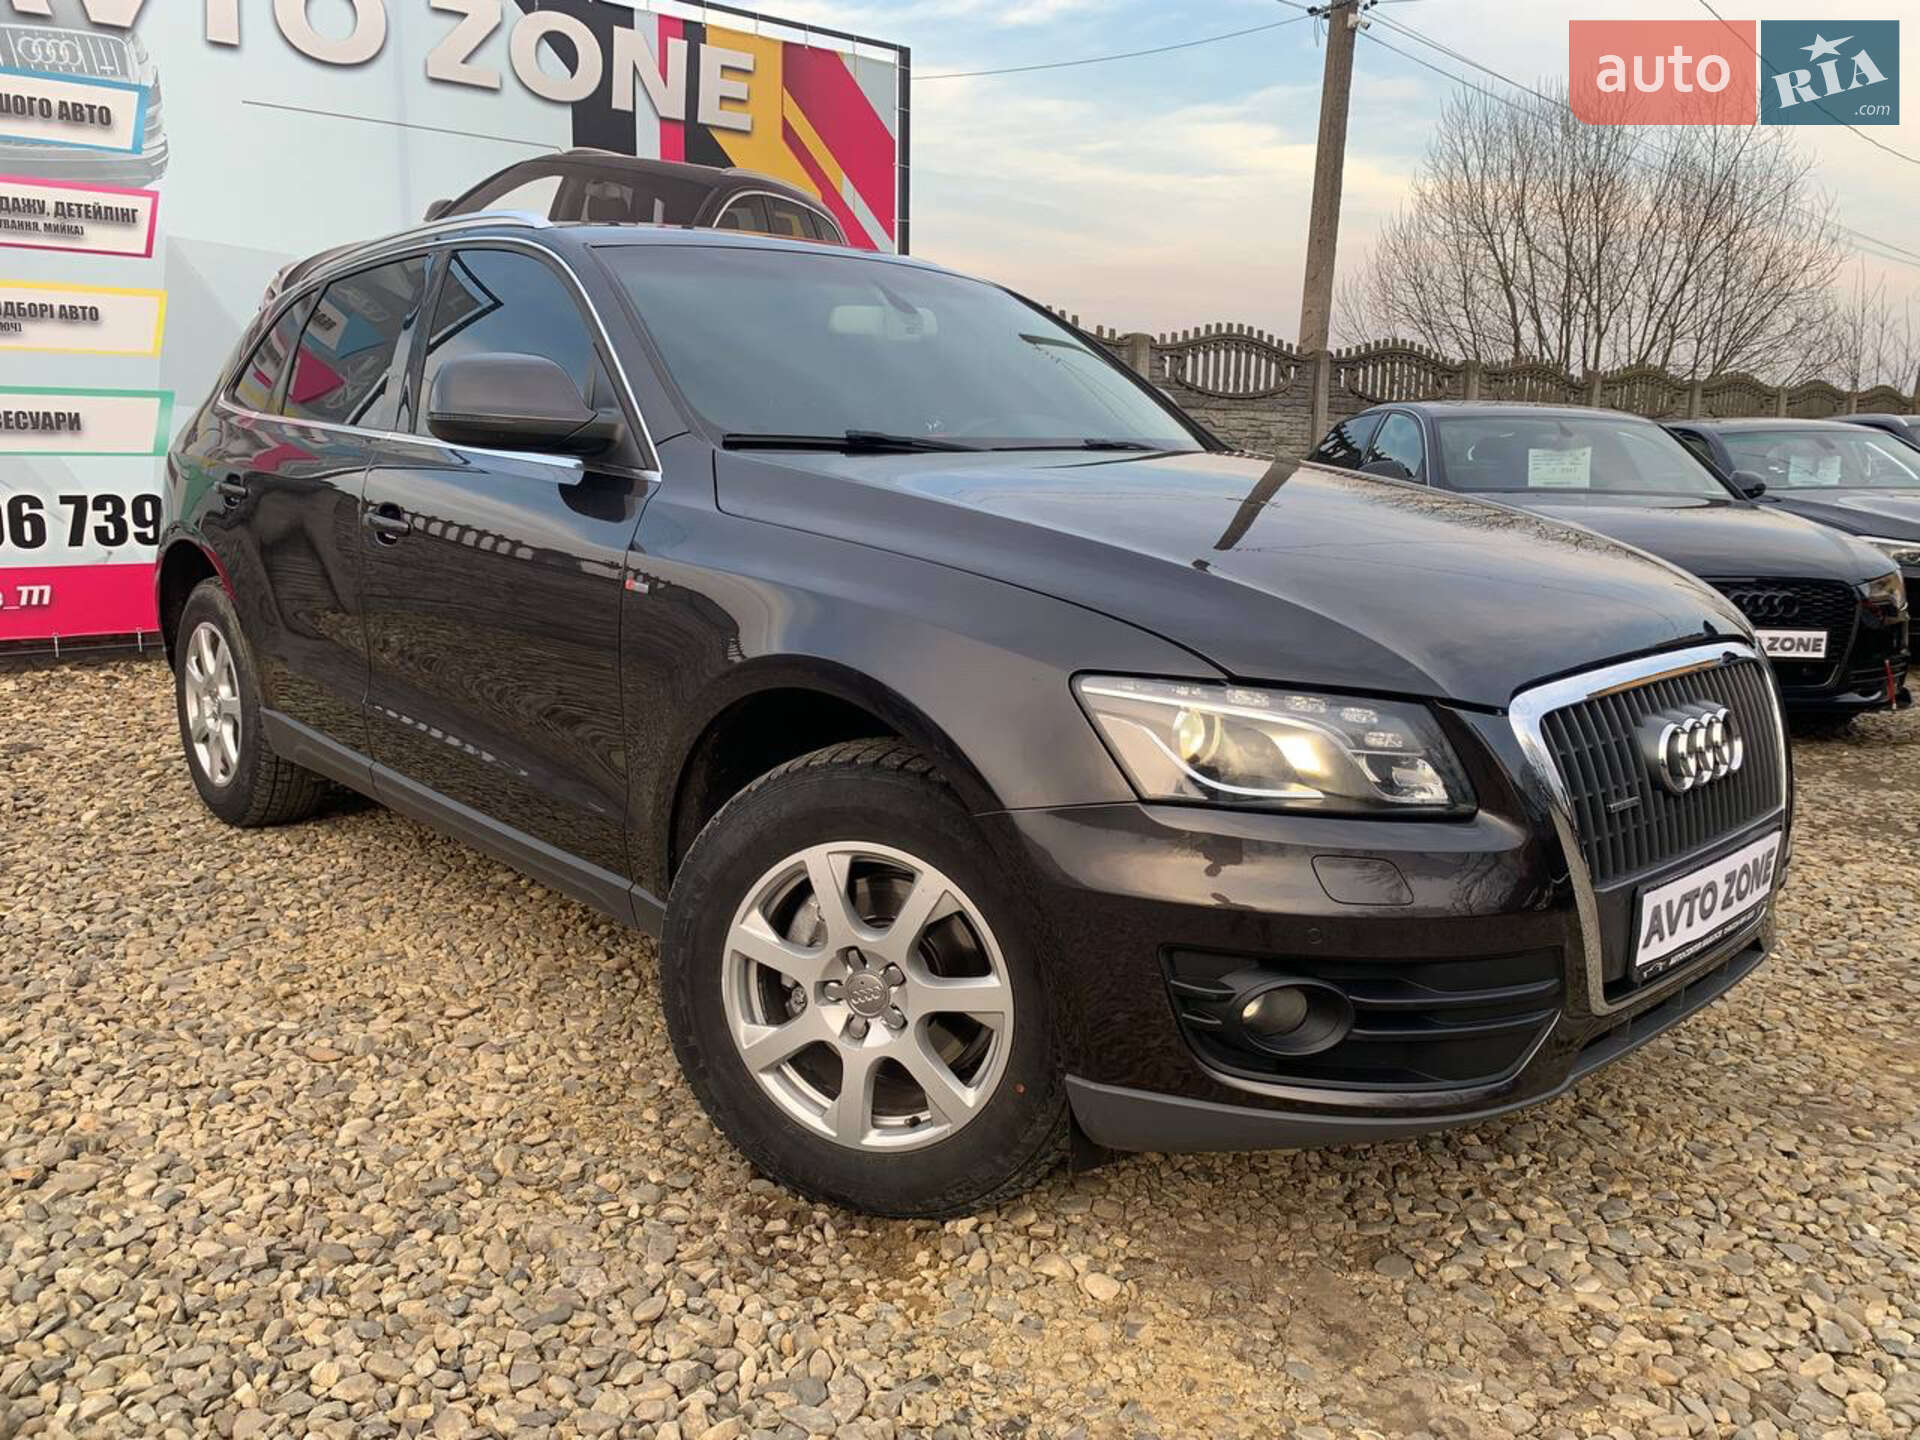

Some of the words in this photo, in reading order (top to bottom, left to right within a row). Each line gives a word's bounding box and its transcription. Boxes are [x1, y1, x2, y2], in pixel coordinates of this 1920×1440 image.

[426, 0, 754, 131] ZONE
[58, 100, 112, 126] АВТО
[54, 201, 139, 224] ДЕТЕЙЛІНГ
[58, 304, 99, 321] АВТО
[0, 410, 82, 431] ЕСУАРИ
[59, 494, 162, 547] 739
[1766, 637, 1823, 652] ZONE
[1642, 880, 1718, 949] AVTO
[1721, 846, 1775, 911] ZONE
